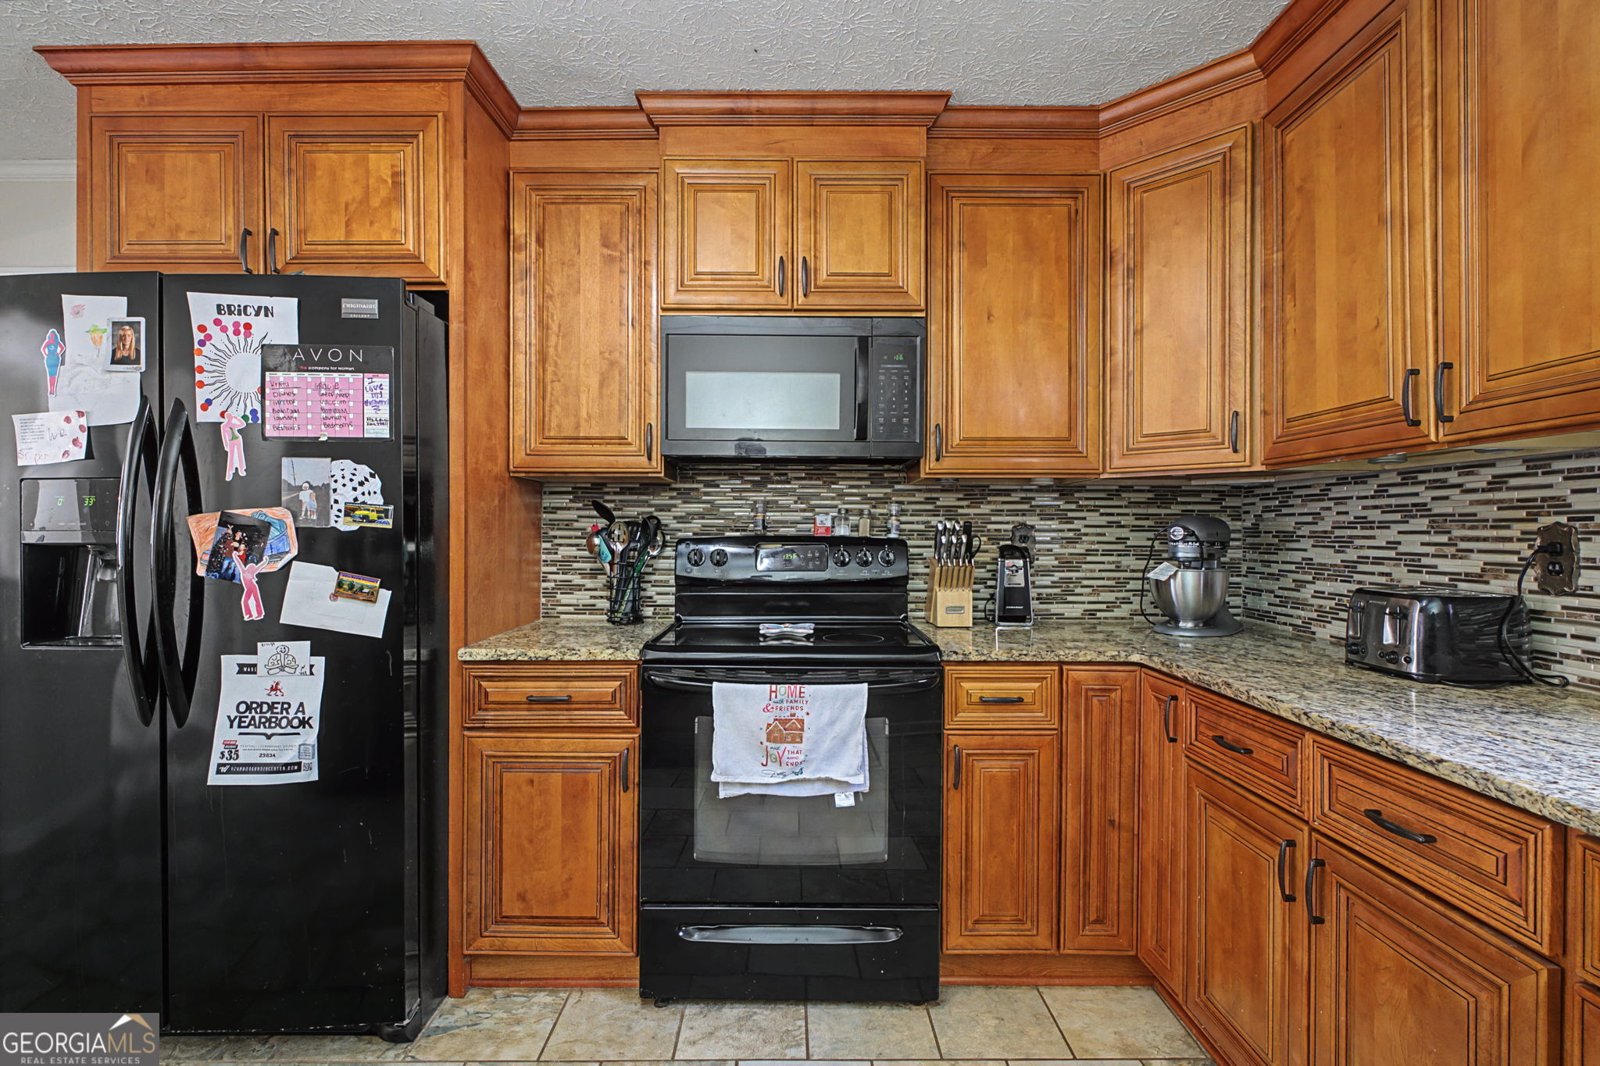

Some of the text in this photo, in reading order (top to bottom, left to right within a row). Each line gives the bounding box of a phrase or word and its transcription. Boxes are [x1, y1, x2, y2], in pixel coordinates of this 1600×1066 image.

[292, 348, 363, 362] AVON
[769, 684, 806, 701] HOME
[235, 700, 306, 716] ORDER A
[762, 703, 774, 713] &
[226, 715, 314, 730] YEARBOOK
[219, 750, 240, 761] $35
[761, 745, 787, 767] JOY
